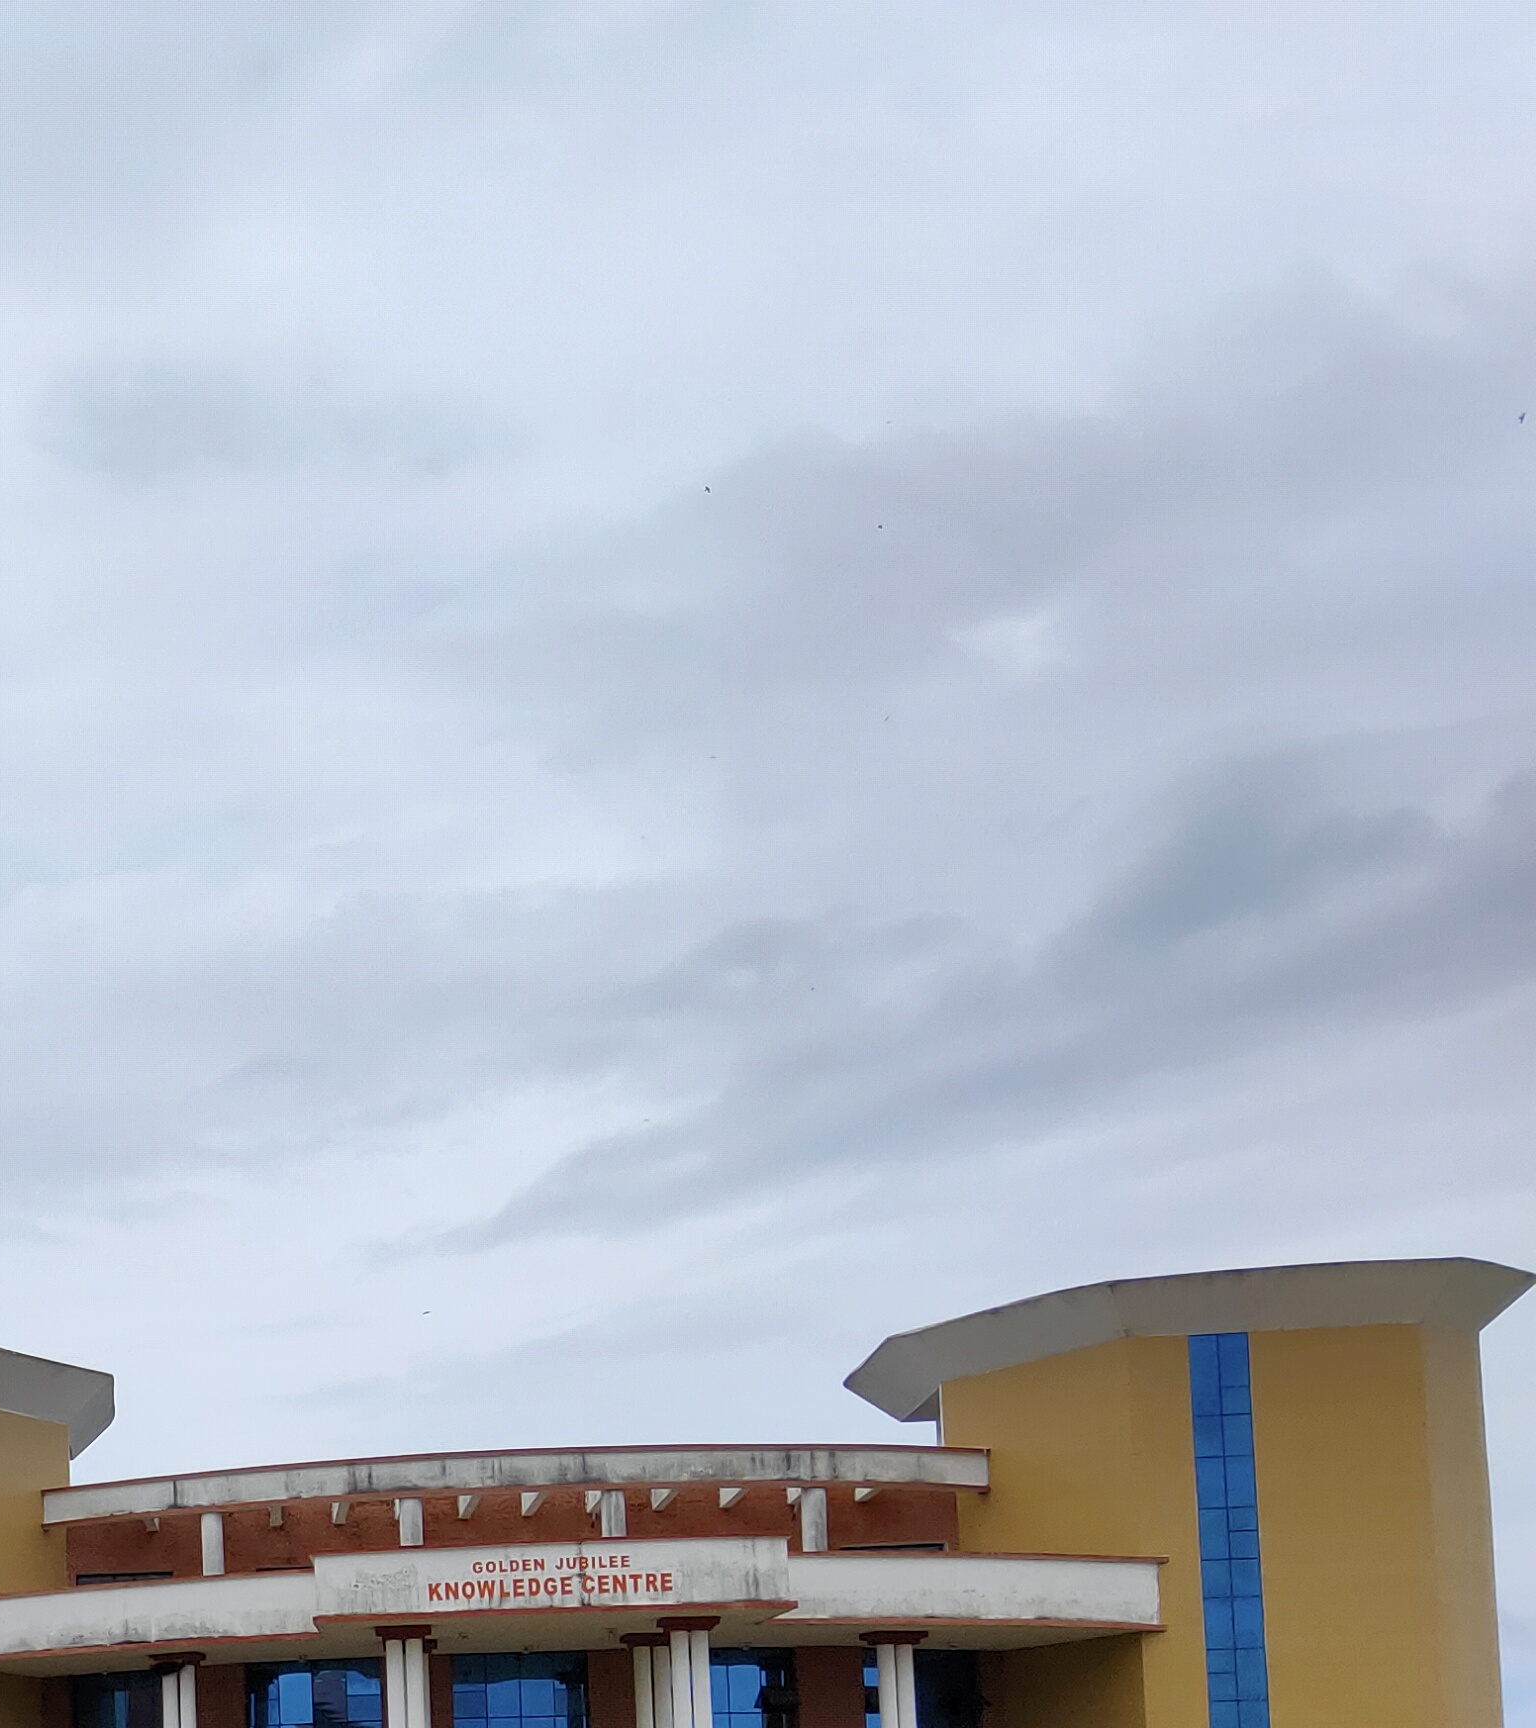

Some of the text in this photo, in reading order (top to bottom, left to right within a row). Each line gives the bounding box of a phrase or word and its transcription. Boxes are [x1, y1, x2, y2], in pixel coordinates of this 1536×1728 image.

[472, 1555, 631, 1574] GOLDEN JUBILEE
[428, 1572, 673, 1601] KNOWLEDGE CENTRE
